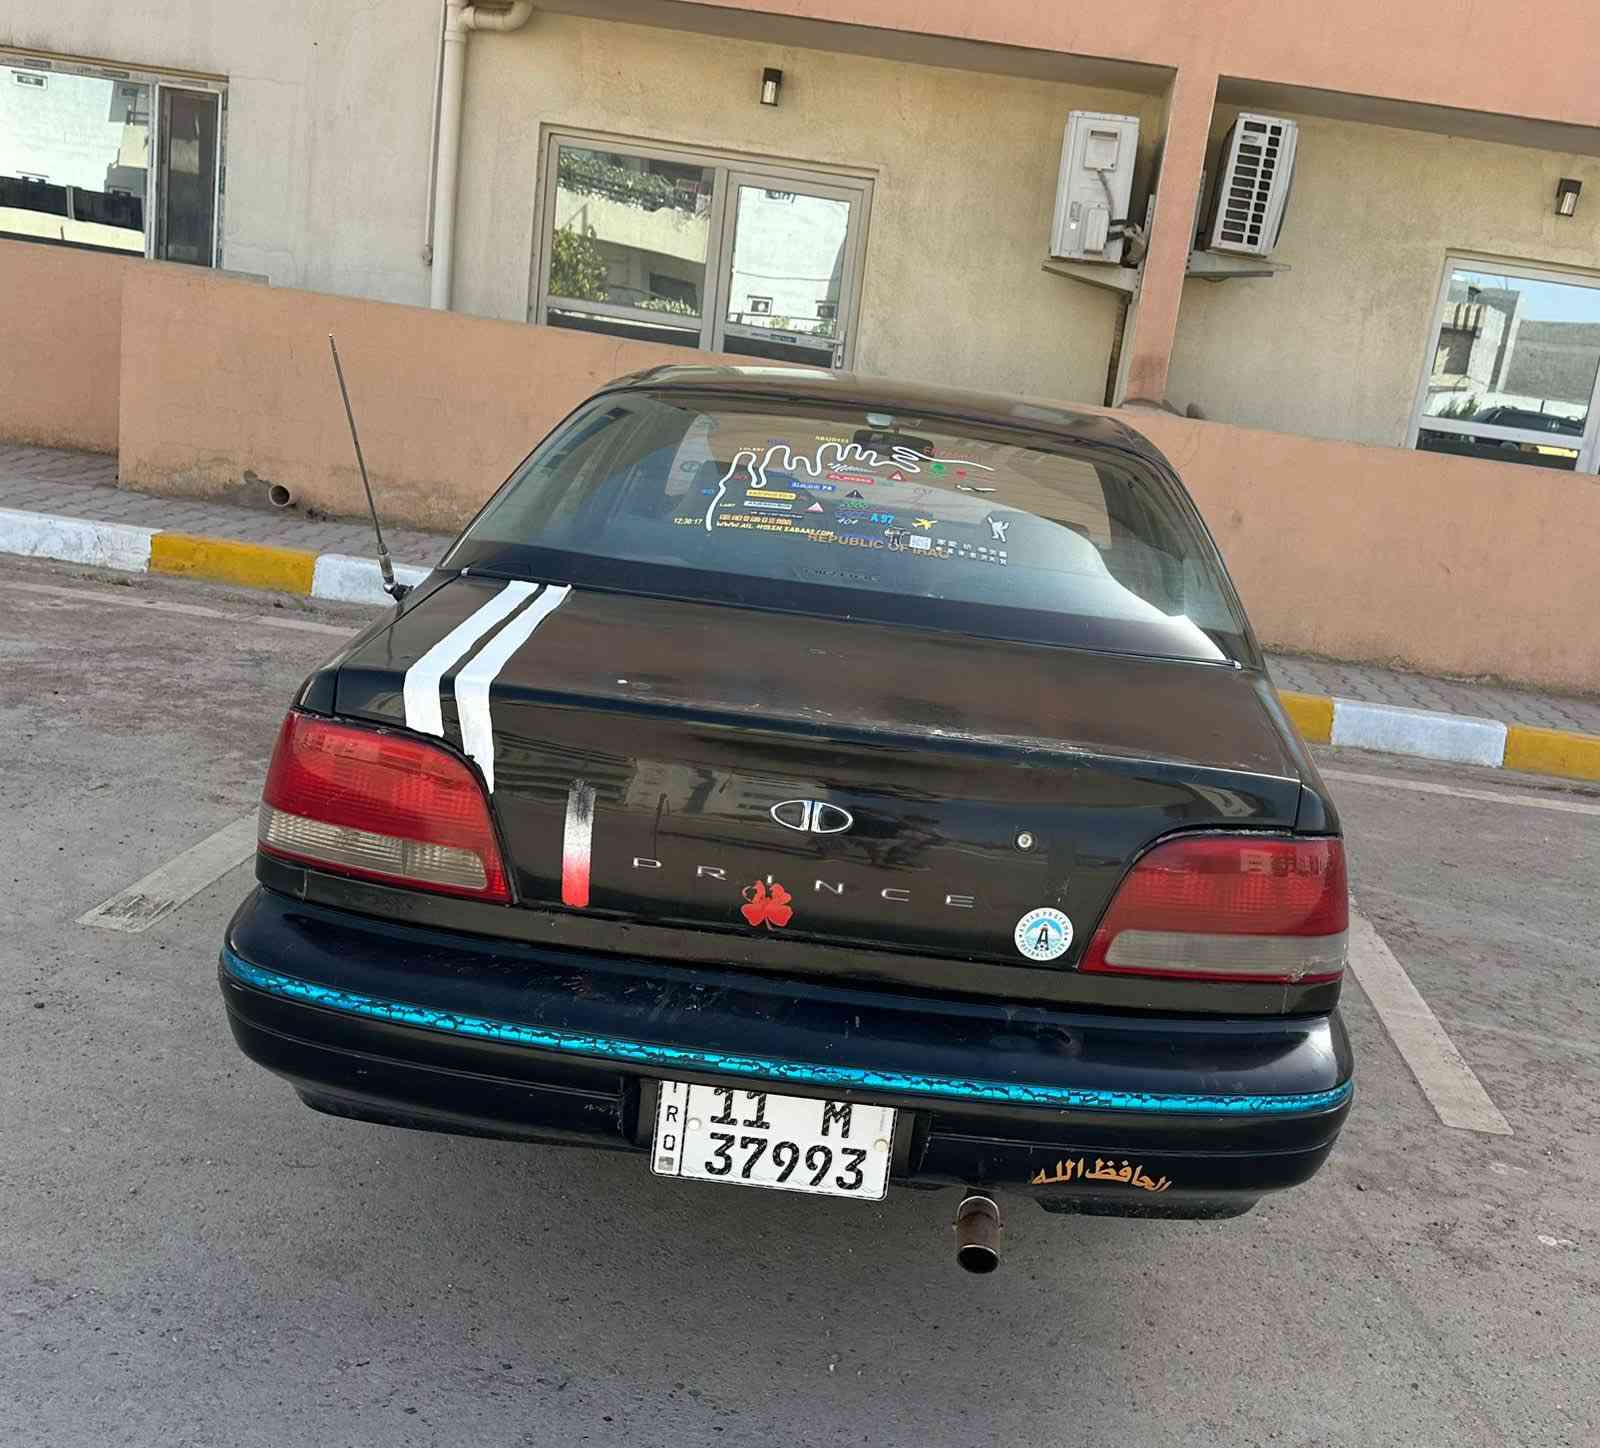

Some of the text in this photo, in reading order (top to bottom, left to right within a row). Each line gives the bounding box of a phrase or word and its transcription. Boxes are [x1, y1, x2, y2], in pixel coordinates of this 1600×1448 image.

[807, 532, 885, 550] REPUBLIC
[632, 857, 975, 909] PRINCE
[710, 1087, 853, 1139] 11 M
[704, 1131, 867, 1191] 37993
